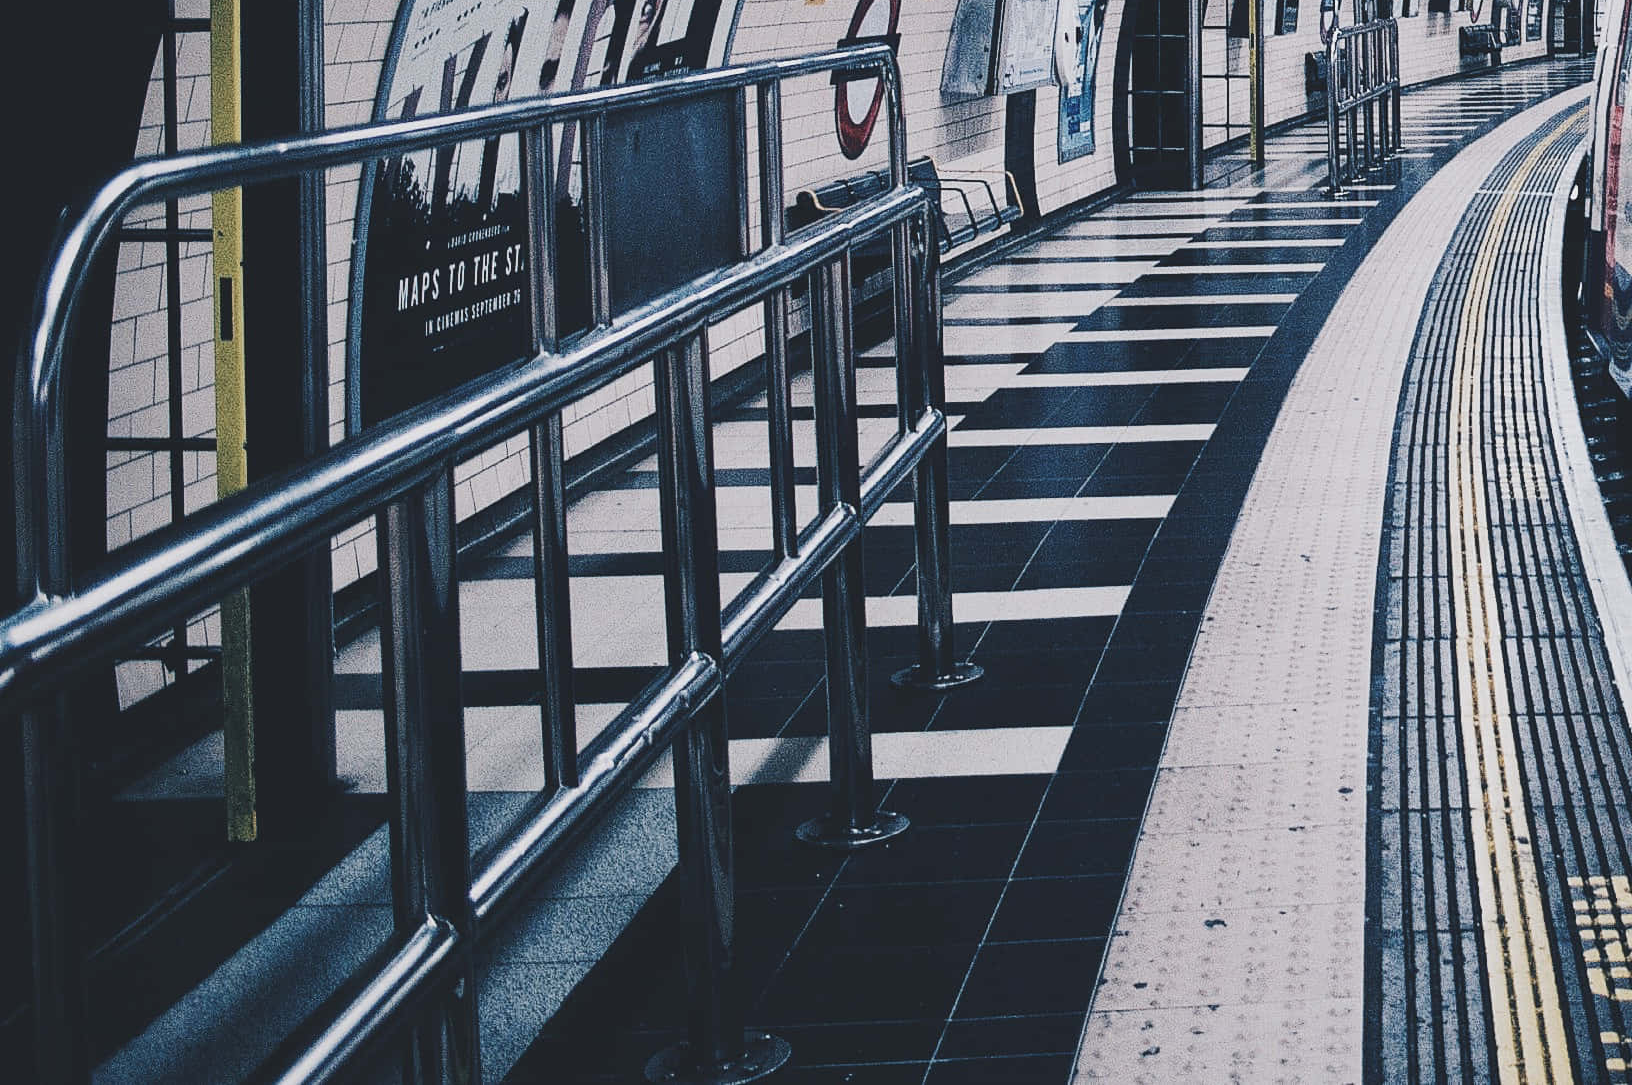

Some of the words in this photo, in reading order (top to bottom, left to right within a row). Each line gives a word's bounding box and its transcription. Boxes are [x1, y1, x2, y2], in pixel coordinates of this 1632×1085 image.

[398, 268, 440, 312] MAPS
[449, 260, 465, 295] TO
[473, 251, 499, 286] THE
[505, 244, 524, 276] ST
[425, 319, 434, 336] IN
[436, 307, 469, 332] CINEMAS
[471, 292, 511, 320] SEPTEMBER
